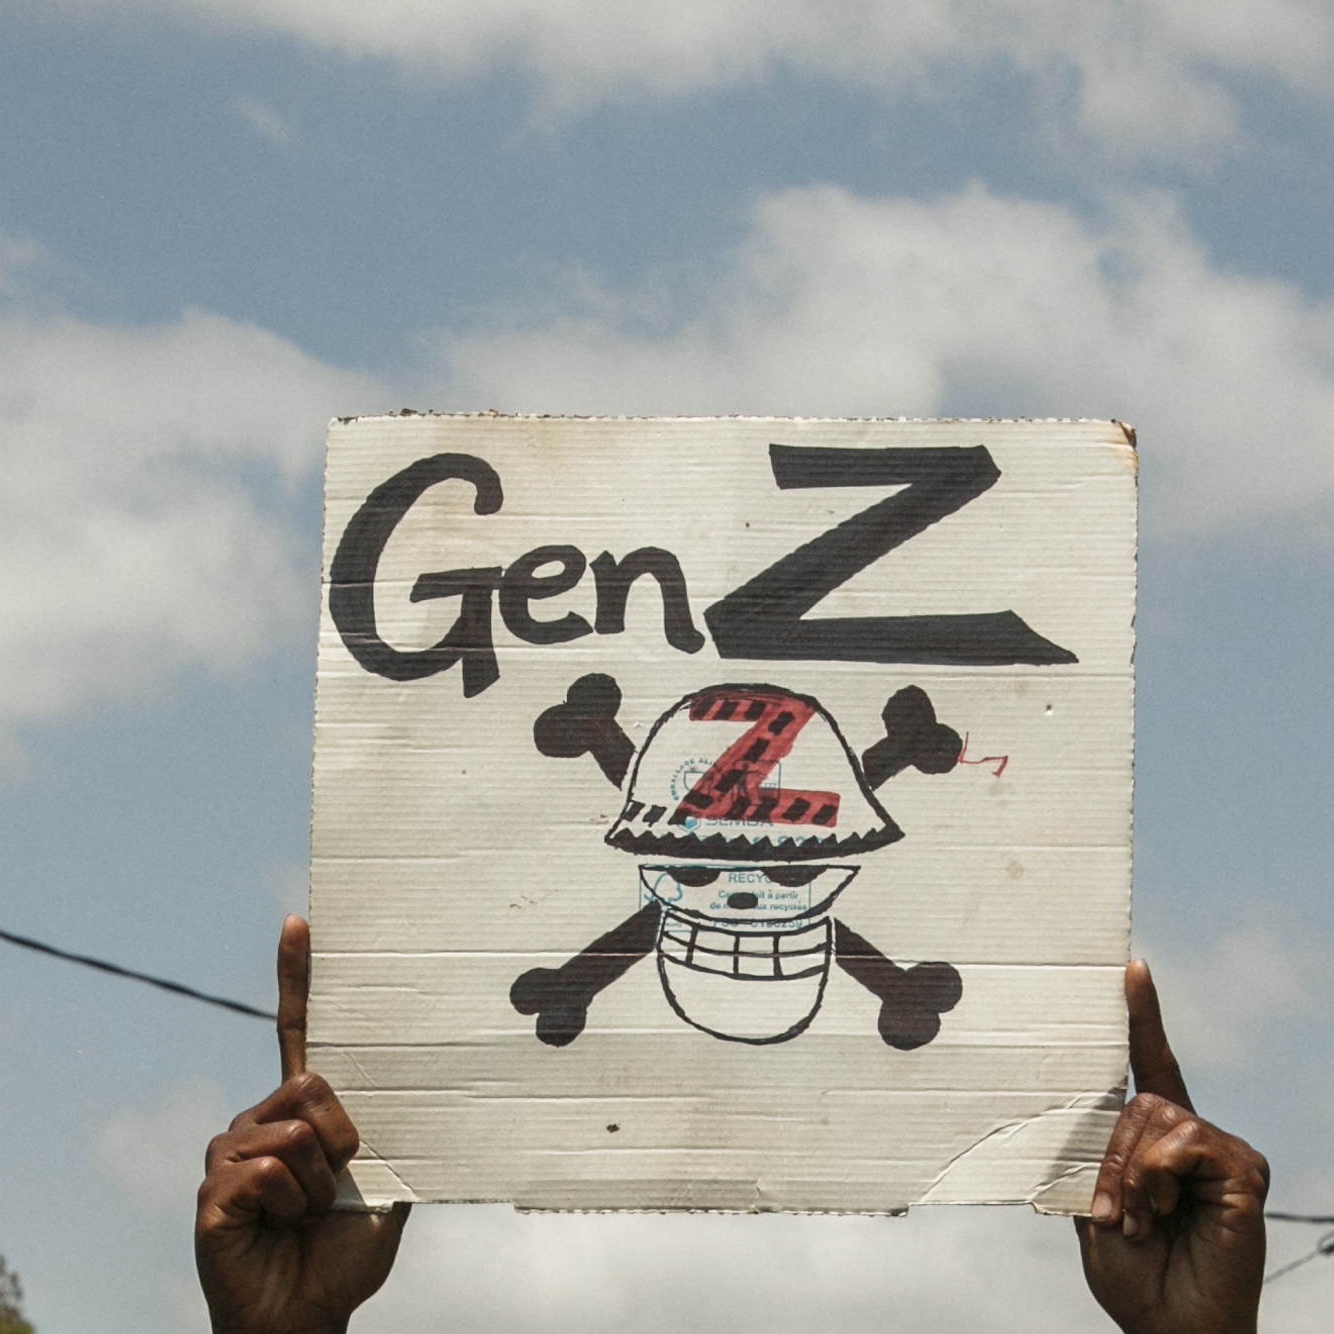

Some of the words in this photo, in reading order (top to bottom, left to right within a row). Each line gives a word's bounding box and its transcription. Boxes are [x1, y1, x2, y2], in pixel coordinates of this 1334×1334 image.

[329, 452, 705, 698] Gen
[704, 443, 1079, 666] Z
[668, 689, 841, 828] Z
[709, 902, 721, 910] de
[770, 901, 807, 911] recyclés
[775, 891, 799, 900] partir
